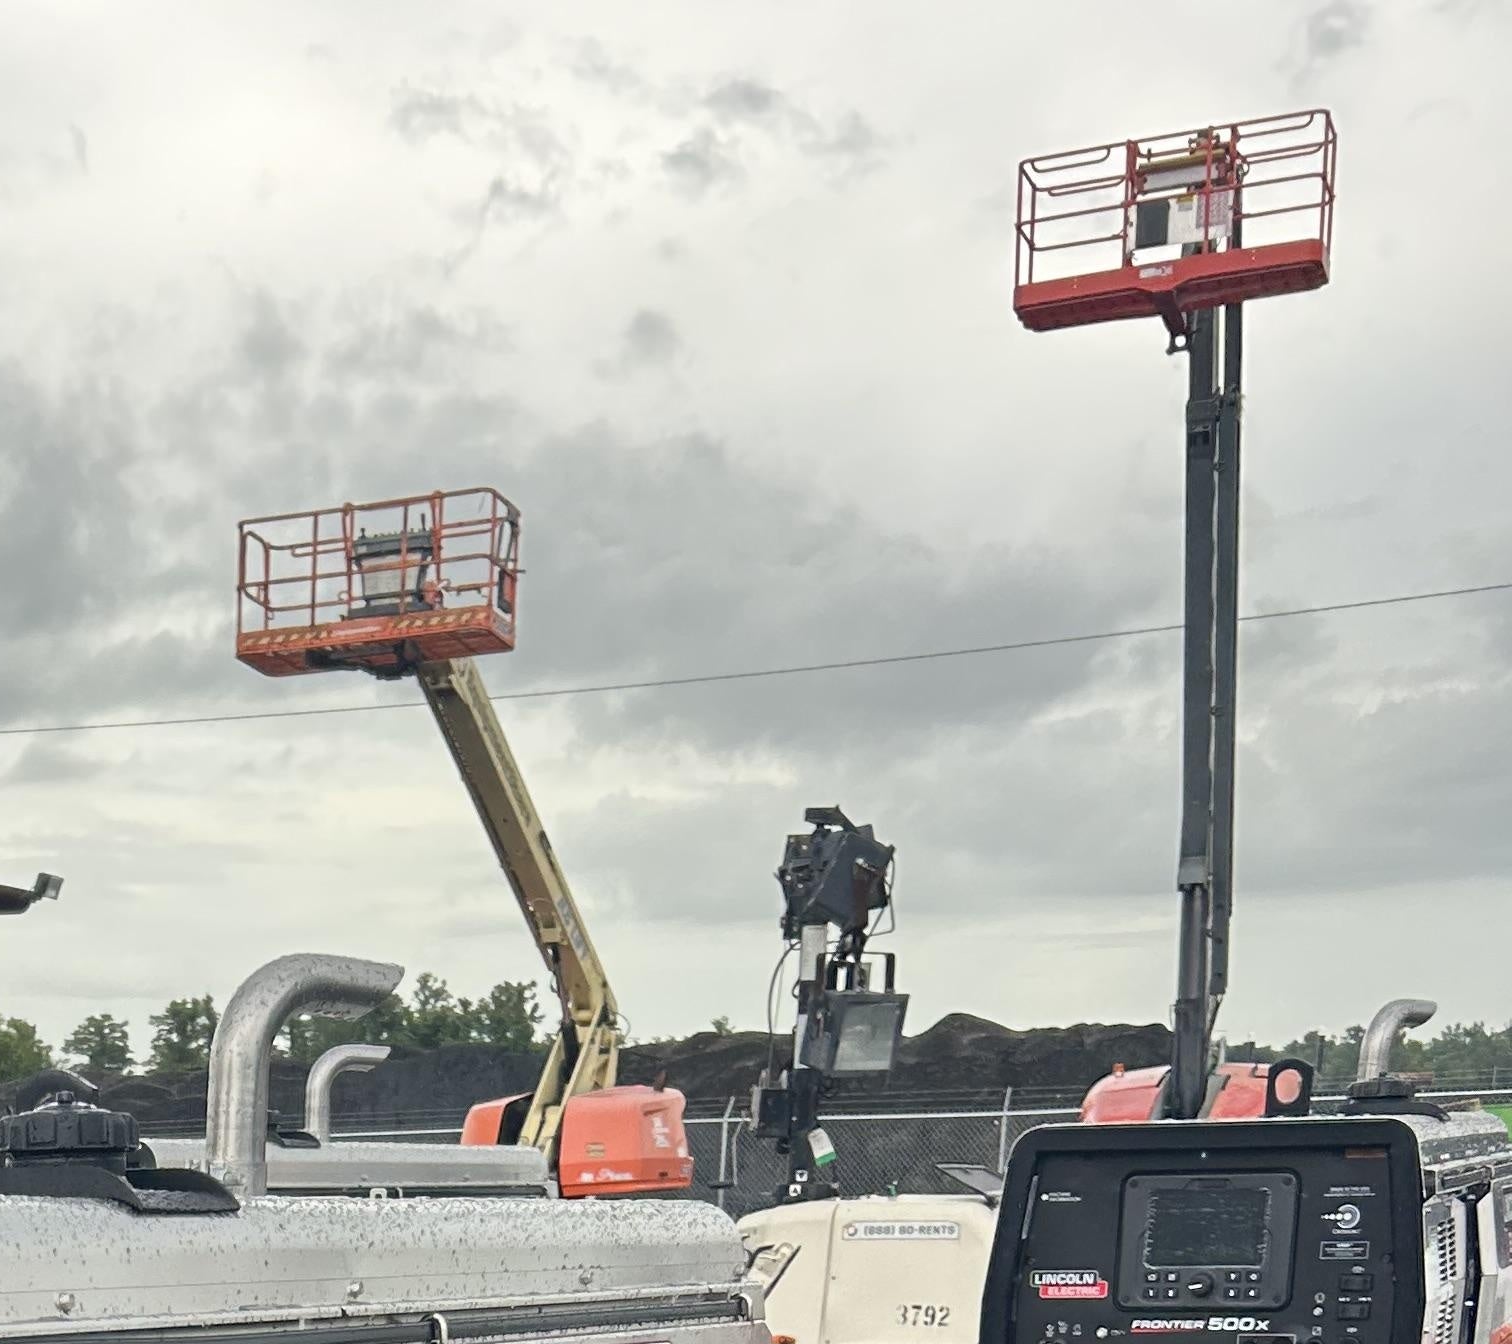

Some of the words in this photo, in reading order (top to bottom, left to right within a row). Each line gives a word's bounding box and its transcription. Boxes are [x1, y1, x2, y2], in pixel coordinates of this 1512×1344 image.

[1034, 1273, 1095, 1285] LINCOLN
[1048, 1286, 1100, 1296] ELECTRIC
[895, 1304, 950, 1327] 3792
[1131, 1320, 1205, 1329] FRONTIER
